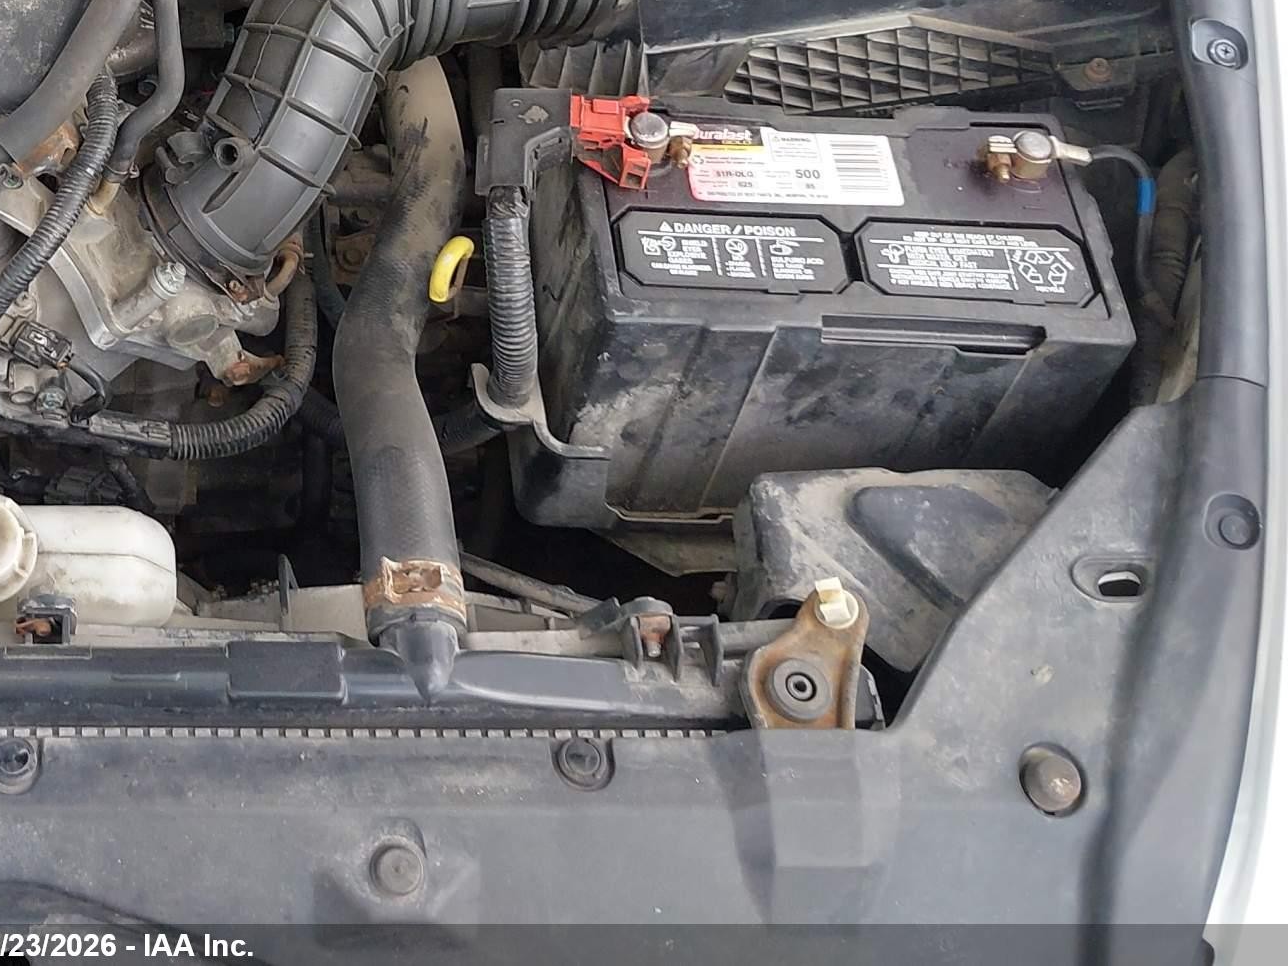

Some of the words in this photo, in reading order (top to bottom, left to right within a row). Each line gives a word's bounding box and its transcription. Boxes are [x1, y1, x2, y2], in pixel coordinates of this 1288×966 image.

[795, 169, 821, 179] 500
[673, 222, 731, 235] DANGER
[744, 225, 796, 237] POISON
